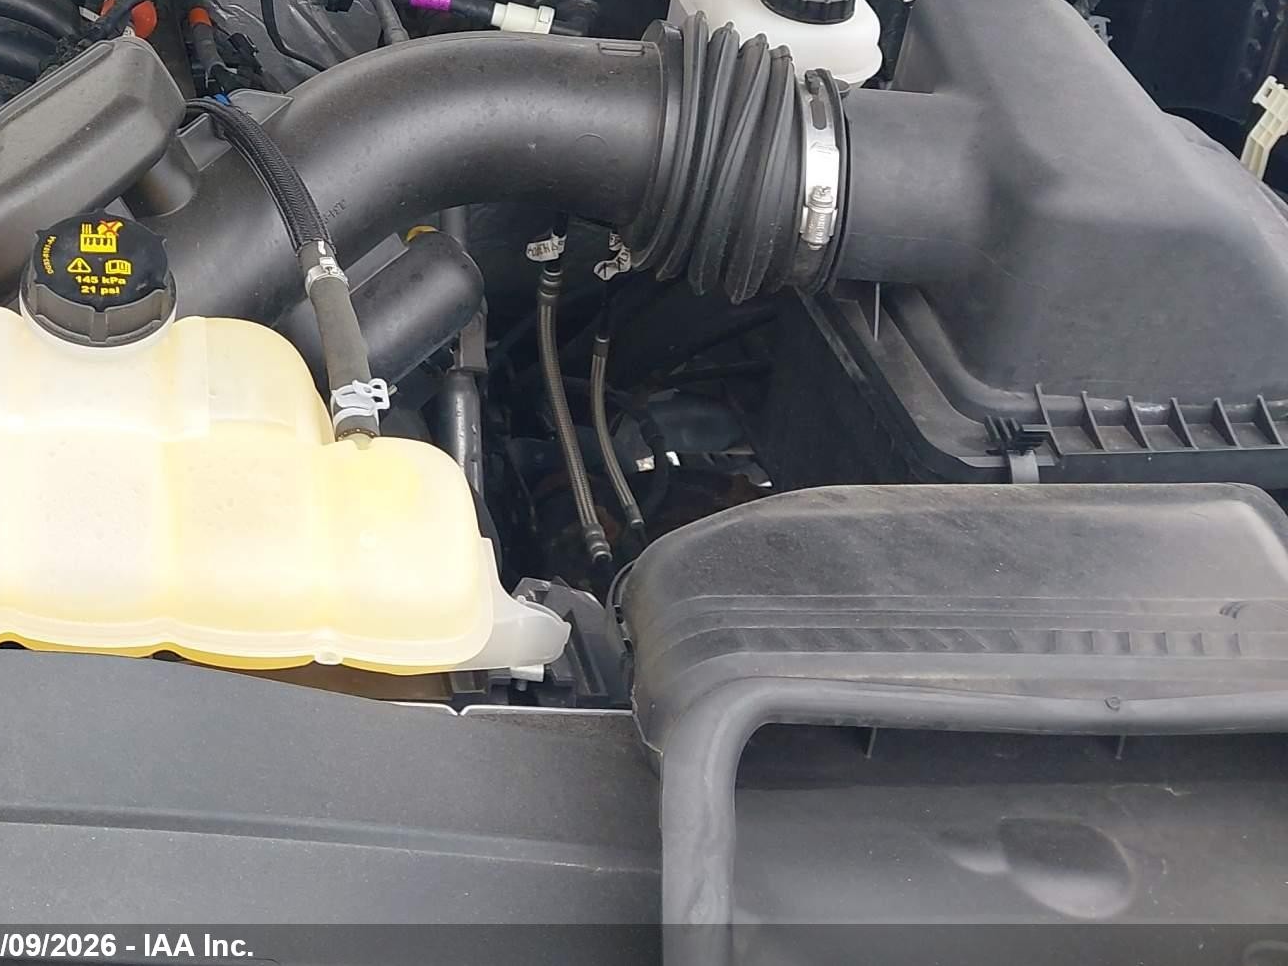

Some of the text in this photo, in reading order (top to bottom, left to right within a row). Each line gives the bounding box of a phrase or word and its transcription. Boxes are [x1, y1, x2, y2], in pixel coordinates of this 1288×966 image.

[75, 275, 127, 285] 145 kPa
[81, 285, 121, 296] 21 psi
